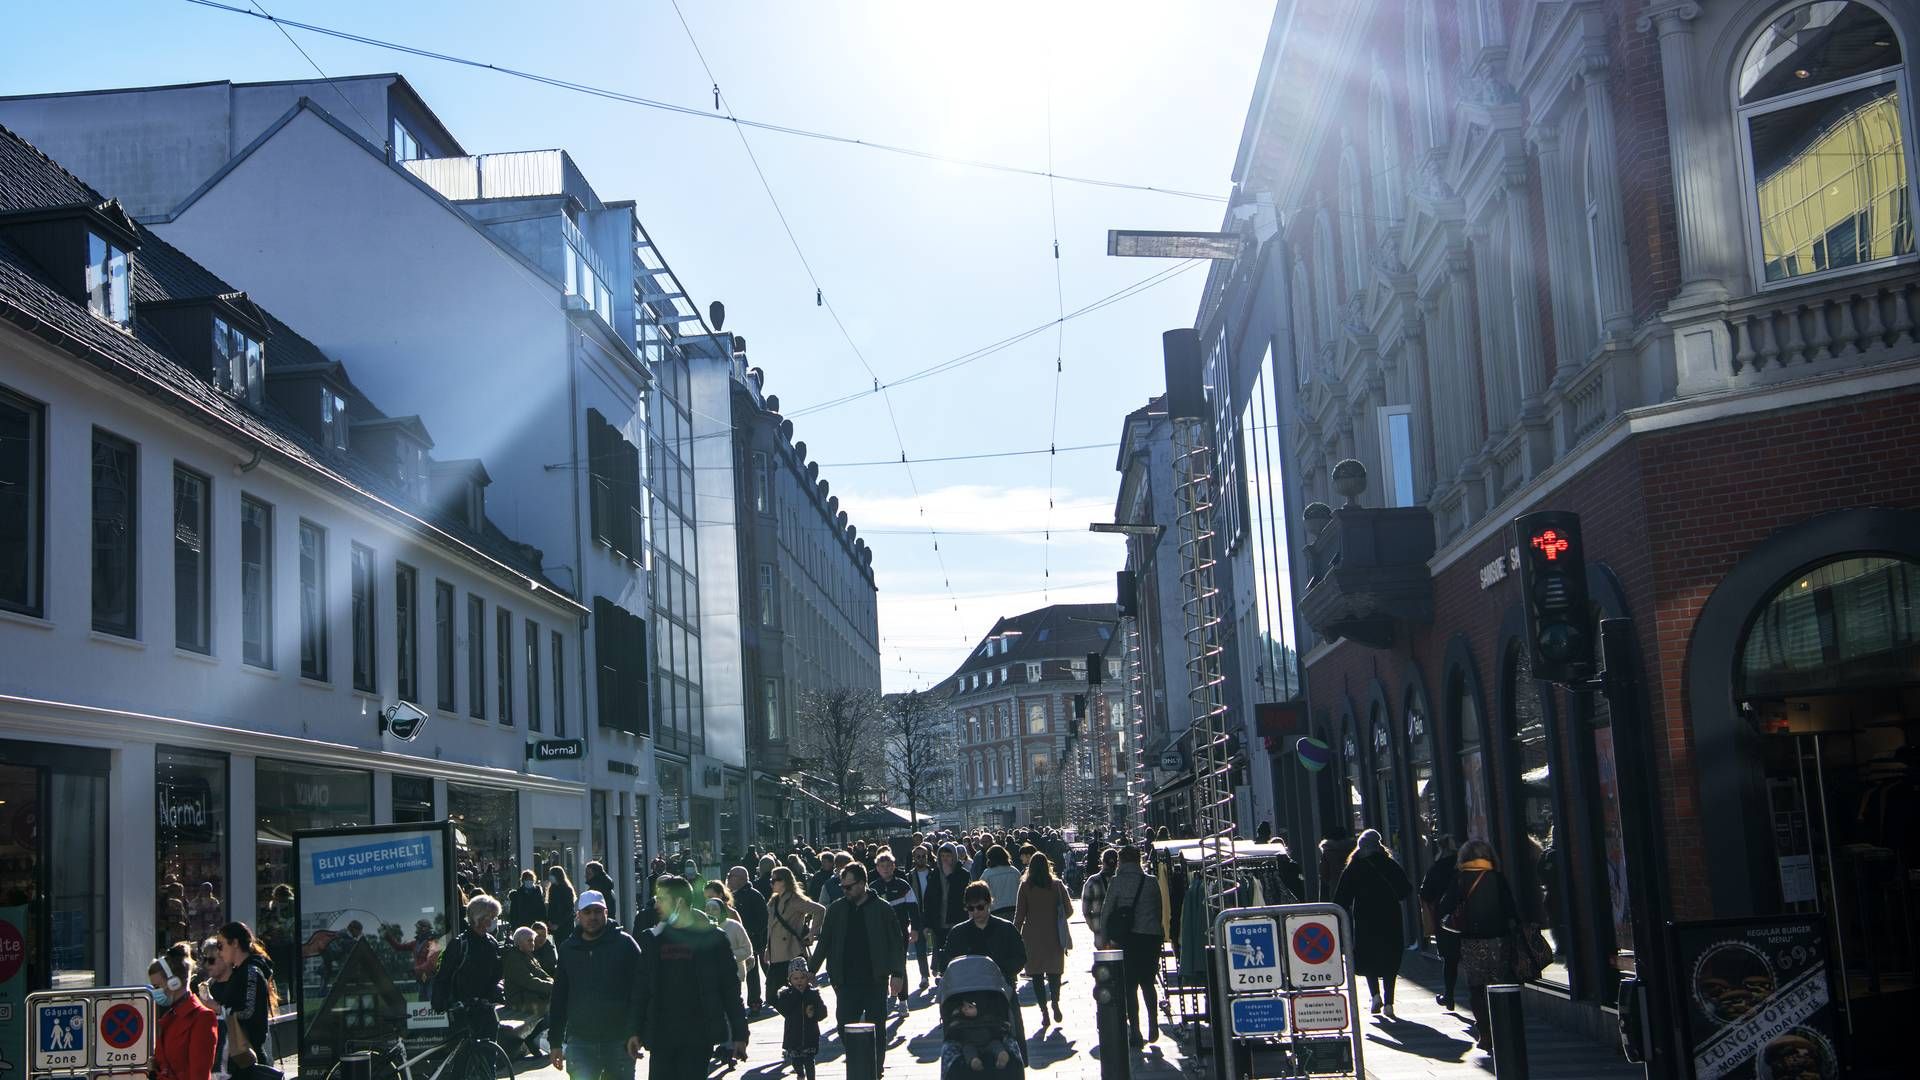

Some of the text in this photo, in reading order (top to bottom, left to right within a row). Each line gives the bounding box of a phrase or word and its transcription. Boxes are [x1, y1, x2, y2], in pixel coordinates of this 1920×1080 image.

[541, 744, 577, 756] Normal
[159, 788, 206, 828] Normal
[318, 843, 425, 870] BLIV SUPERHELT!
[320, 871, 336, 880] Sæt
[336, 867, 372, 878] retningen
[373, 864, 384, 873] for
[396, 858, 428, 869] forening
[1235, 926, 1268, 936] Gågade
[1746, 928, 1781, 937] REGULAR
[1238, 974, 1273, 984] Zone
[1302, 973, 1332, 982] Zone
[44, 1007, 79, 1017] Gågade
[1702, 981, 1821, 1066] LUNCH OFFER
[1718, 998, 1821, 1072] MONDAY-FRIDAY 11-15
[46, 1054, 77, 1065] Zone
[106, 1052, 137, 1063] Zone
